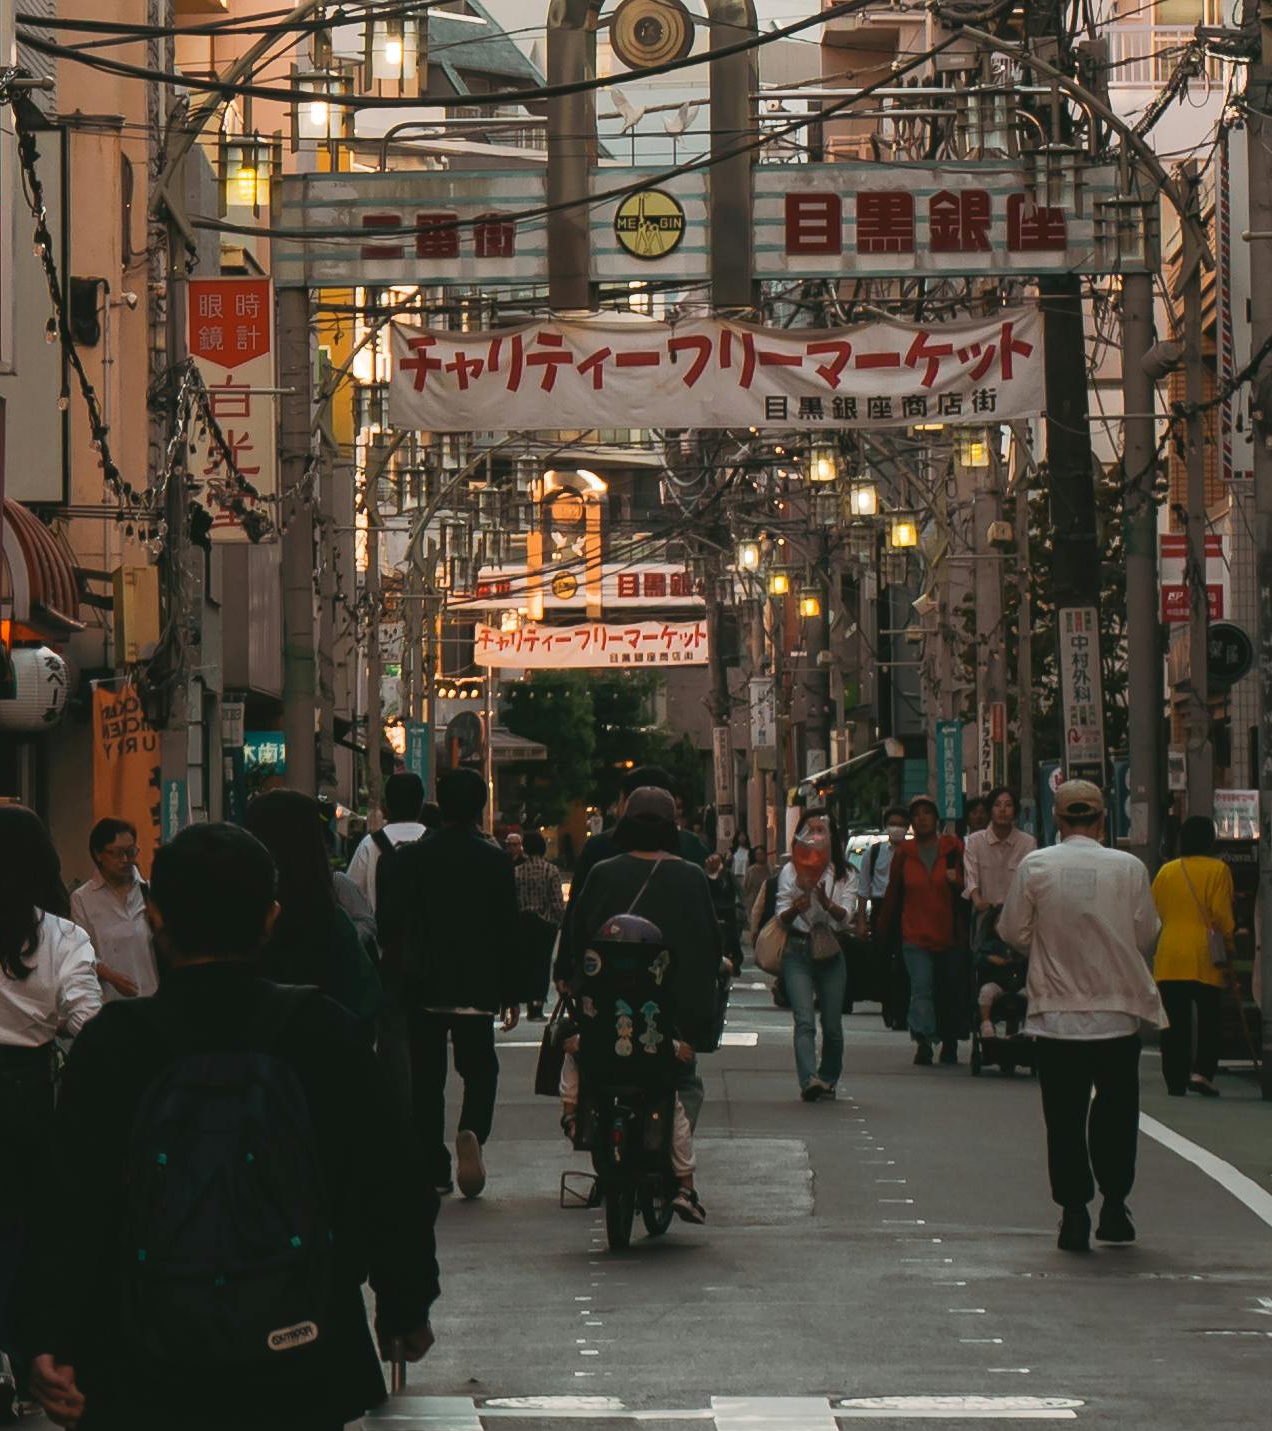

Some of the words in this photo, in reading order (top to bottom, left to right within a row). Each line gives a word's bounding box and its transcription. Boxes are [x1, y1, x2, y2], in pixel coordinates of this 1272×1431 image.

[785, 189, 1067, 256] 目黒銀座
[197, 293, 225, 352] 眼鏡
[234, 293, 262, 351] 時計
[398, 320, 1034, 393] チャリティーフリーマーケット
[764, 388, 999, 422] 目黒銀座商店街
[477, 624, 707, 653] チャリティーフリーマーケット
